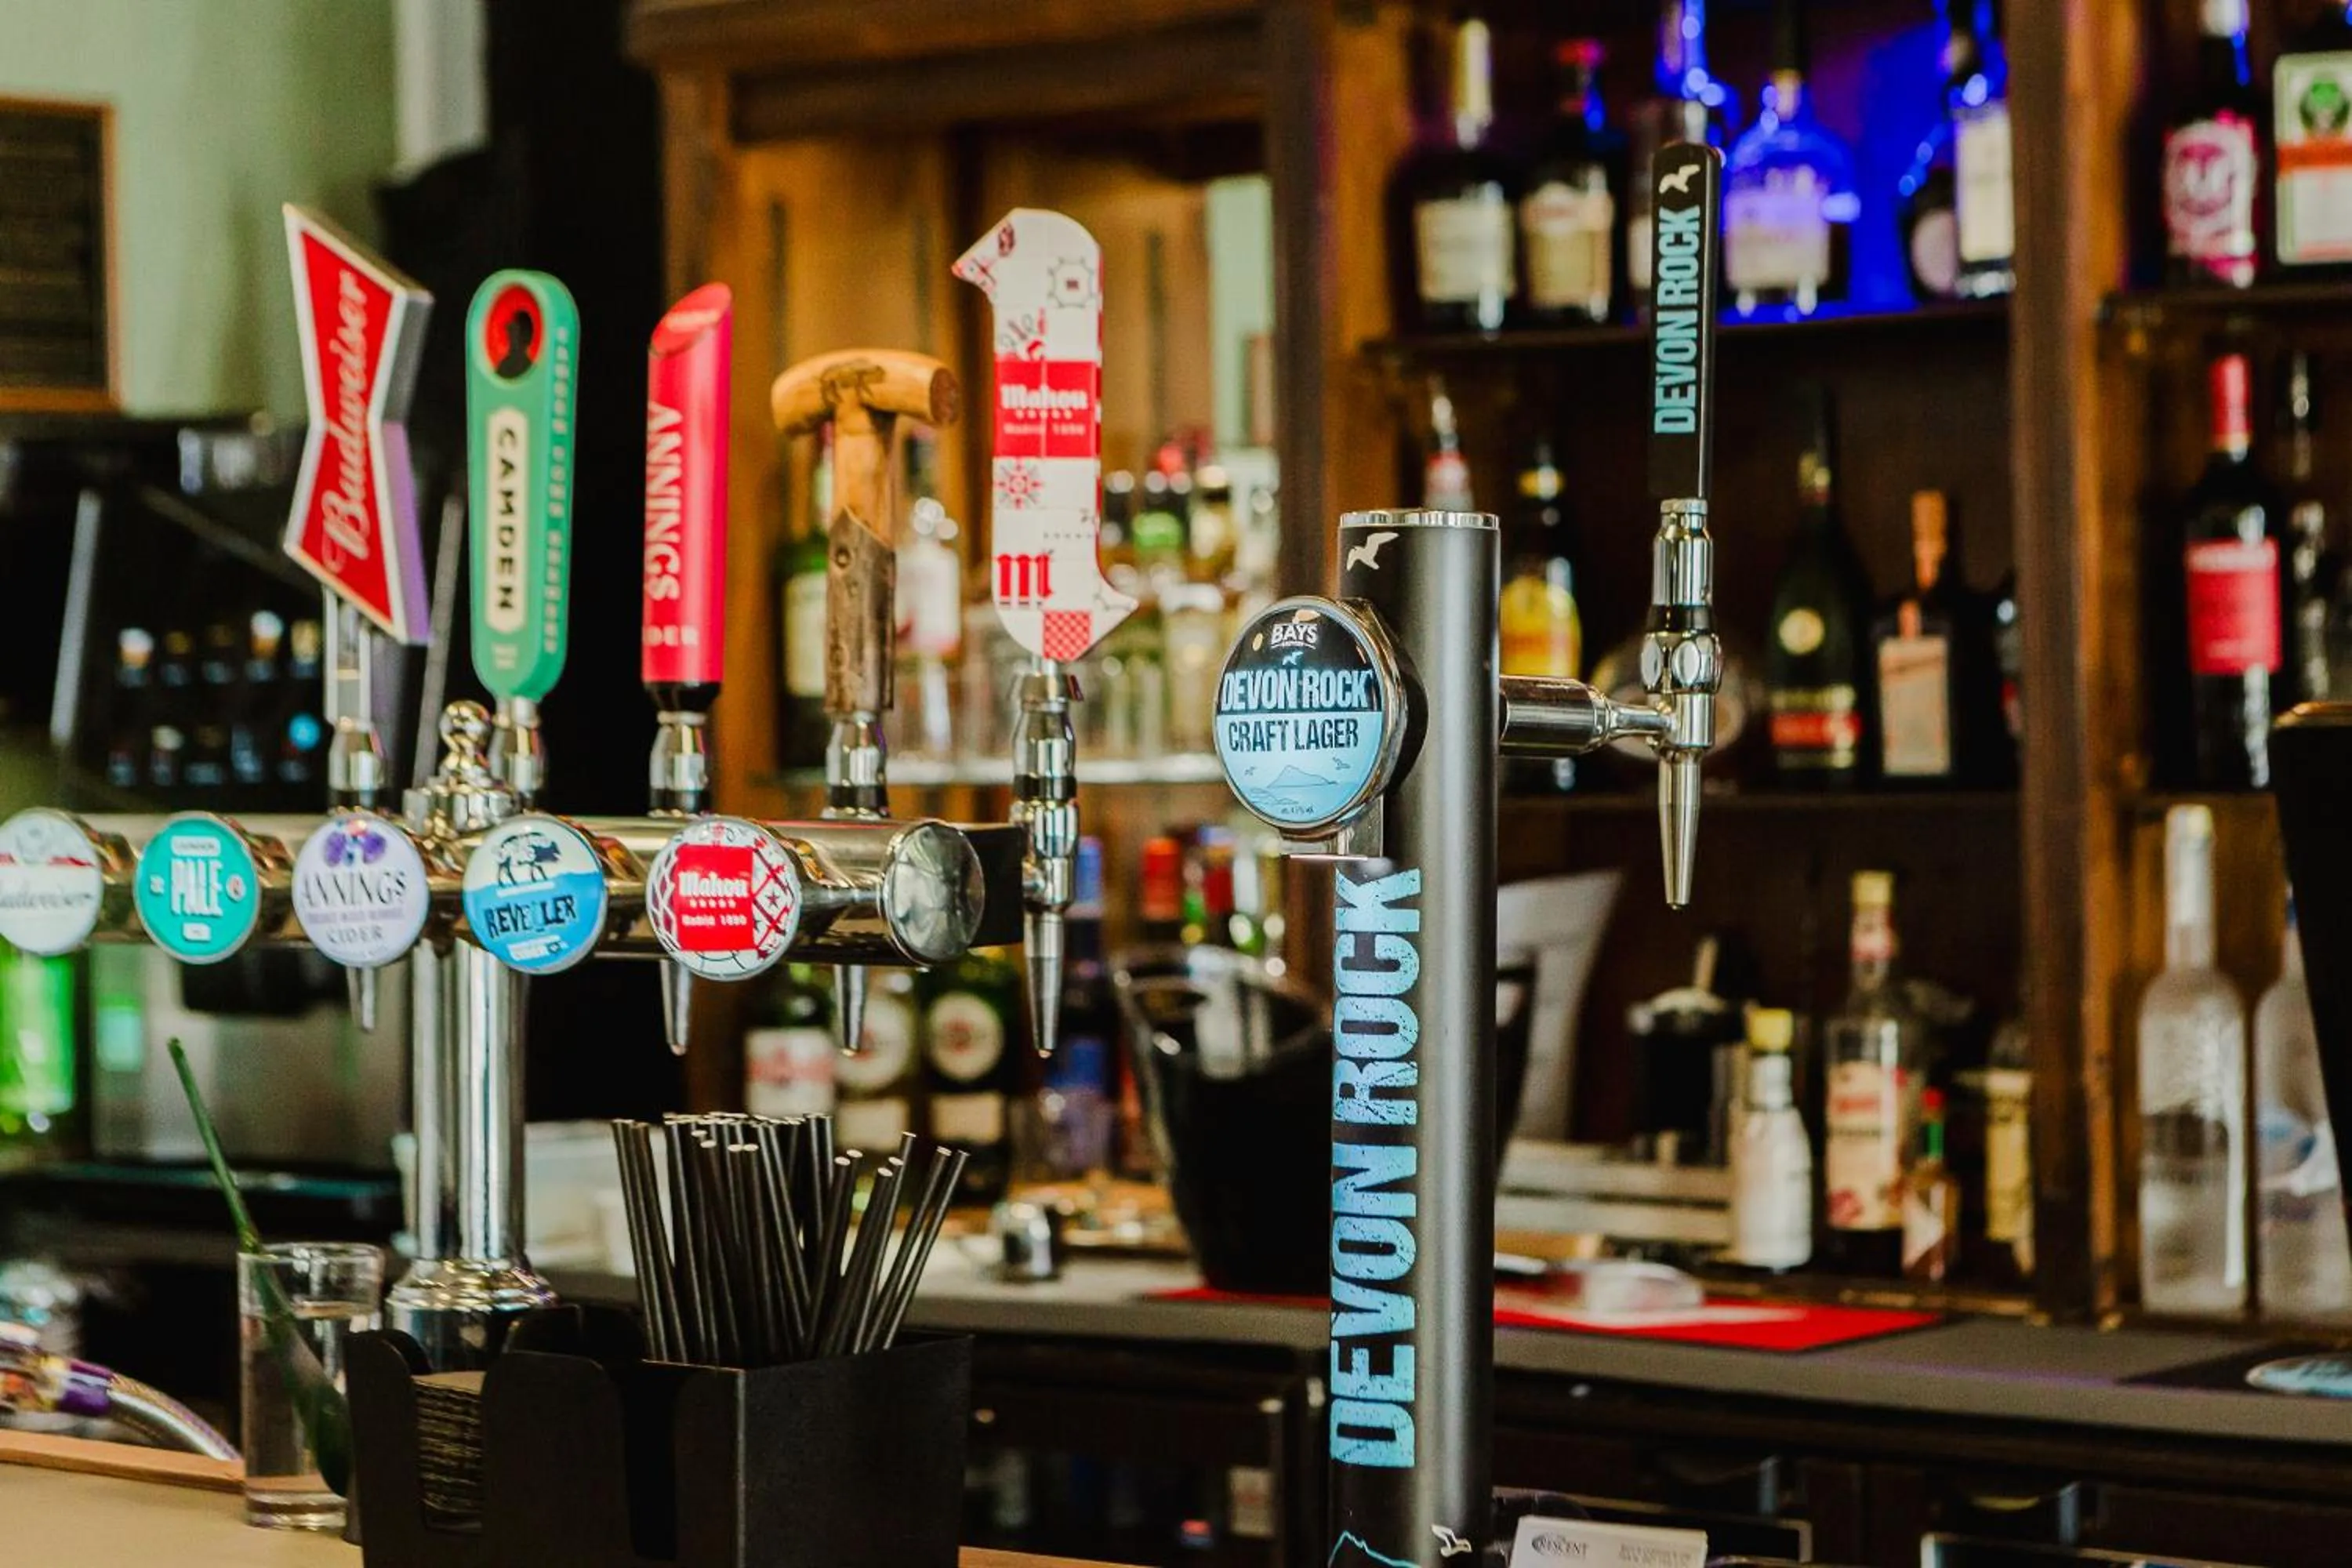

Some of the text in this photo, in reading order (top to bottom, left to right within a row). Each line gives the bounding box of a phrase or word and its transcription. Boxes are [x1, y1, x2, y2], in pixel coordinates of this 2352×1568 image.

[1654, 205, 1701, 434] DEVON ROCK
[321, 269, 370, 574] Budweiser
[643, 401, 682, 601] ANNINGS
[496, 426, 517, 612] CAMDEN
[1220, 669, 1372, 712] DEVON ROCK
[1271, 623, 1318, 644] BAYS
[1229, 717, 1359, 752] CRAFT LAGER
[1330, 868, 1422, 1468] DEVON ROCK
